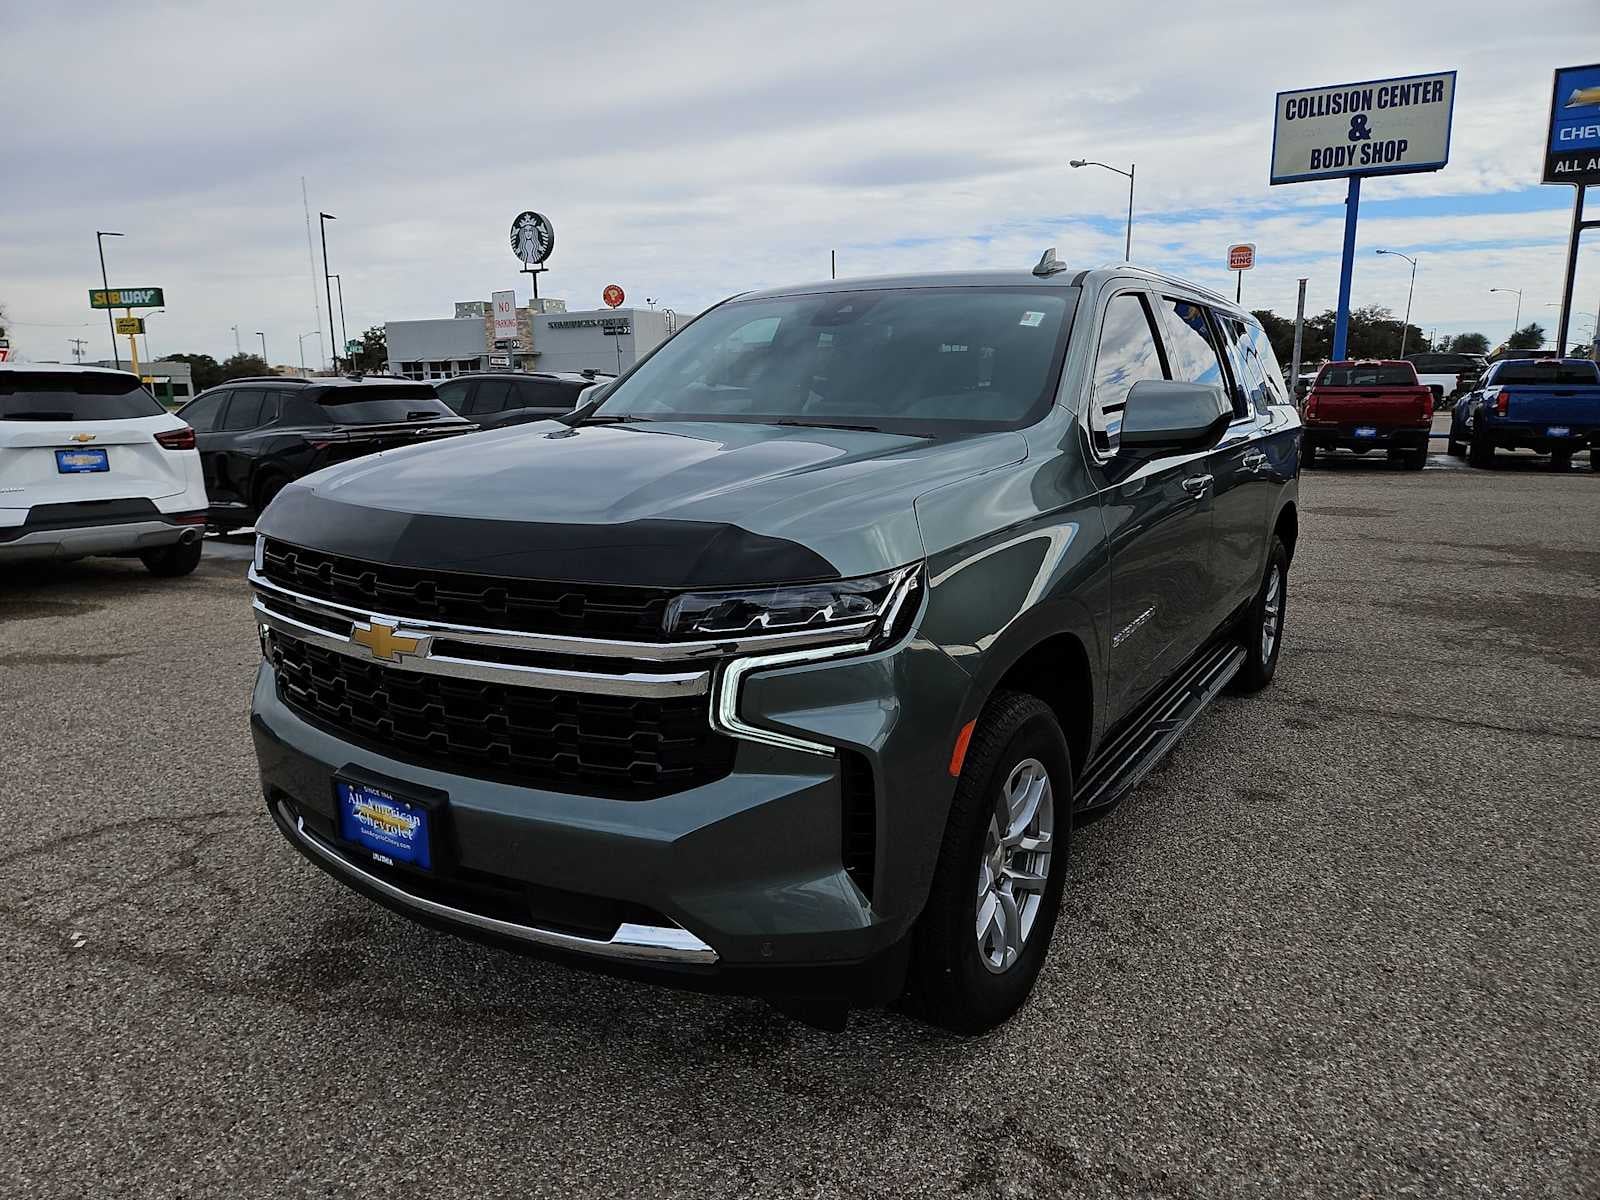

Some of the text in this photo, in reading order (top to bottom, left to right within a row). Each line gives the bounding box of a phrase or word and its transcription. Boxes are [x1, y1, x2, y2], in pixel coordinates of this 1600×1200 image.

[1285, 80, 1444, 121] COLLISION CENTER
[1348, 114, 1372, 142] &
[1310, 139, 1408, 170] BODY SHOP
[1555, 157, 1600, 173] ALL A
[1230, 257, 1251, 265] KING
[498, 302, 510, 313] NO
[495, 318, 518, 328] PARKING
[348, 792, 421, 827] All American
[359, 811, 414, 841] Chevrolet
